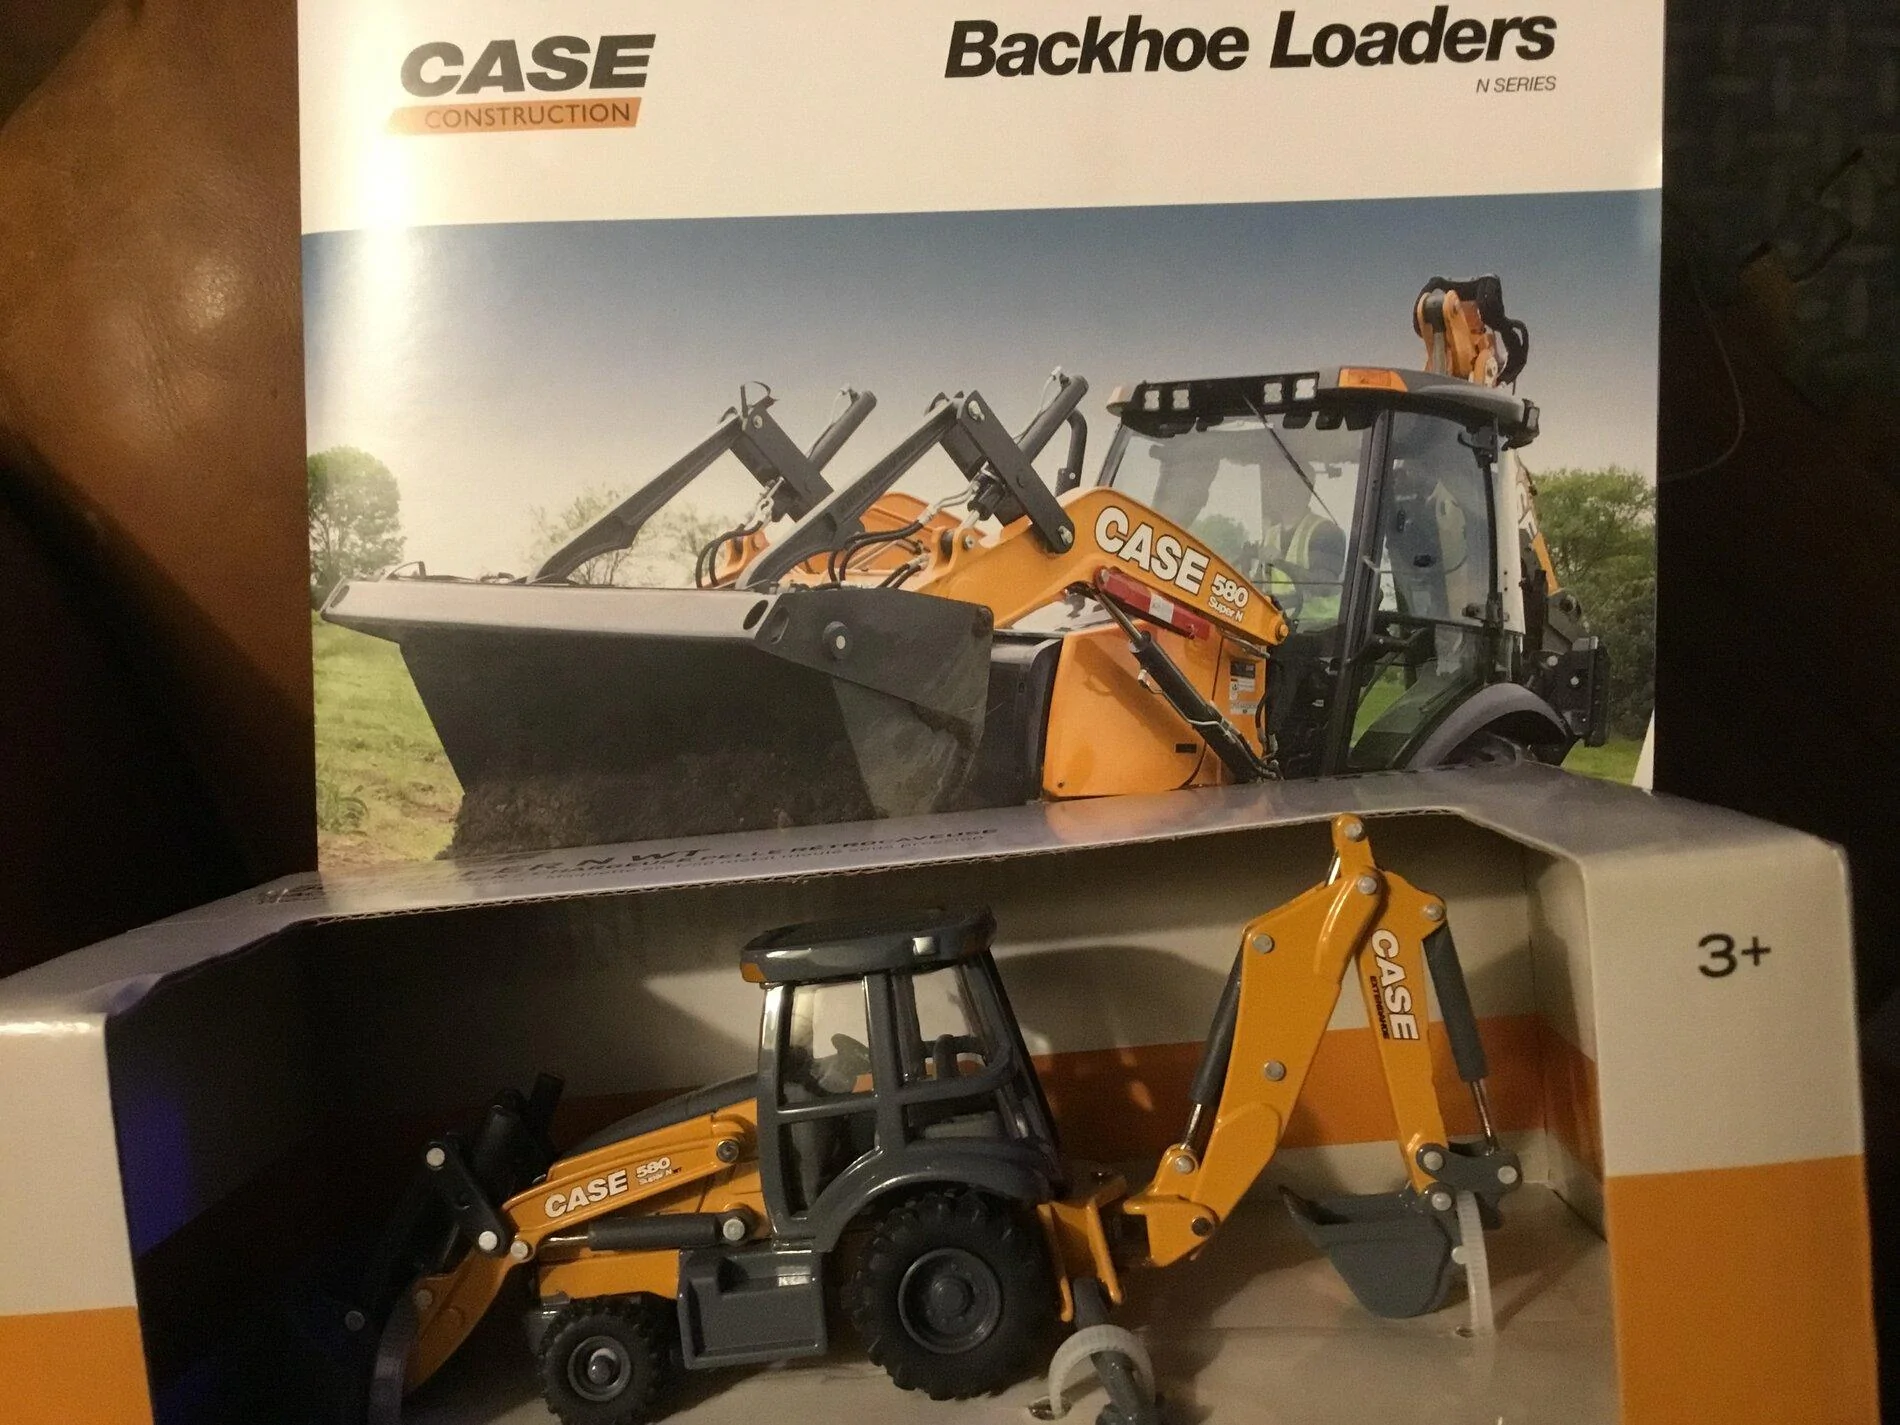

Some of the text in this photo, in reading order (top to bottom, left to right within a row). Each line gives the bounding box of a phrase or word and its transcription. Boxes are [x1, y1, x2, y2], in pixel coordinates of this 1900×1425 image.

[400, 33, 656, 98] CASE
[944, 5, 1557, 79] Backhoe Loaders
[423, 102, 632, 129] CONSTRUCTION
[1476, 75, 1557, 93] N SERIES
[1094, 505, 1249, 608] CASE 580
[1371, 929, 1420, 1040] CASE
[1698, 933, 1771, 978] 3+
[544, 1156, 671, 1218] CASE 580
